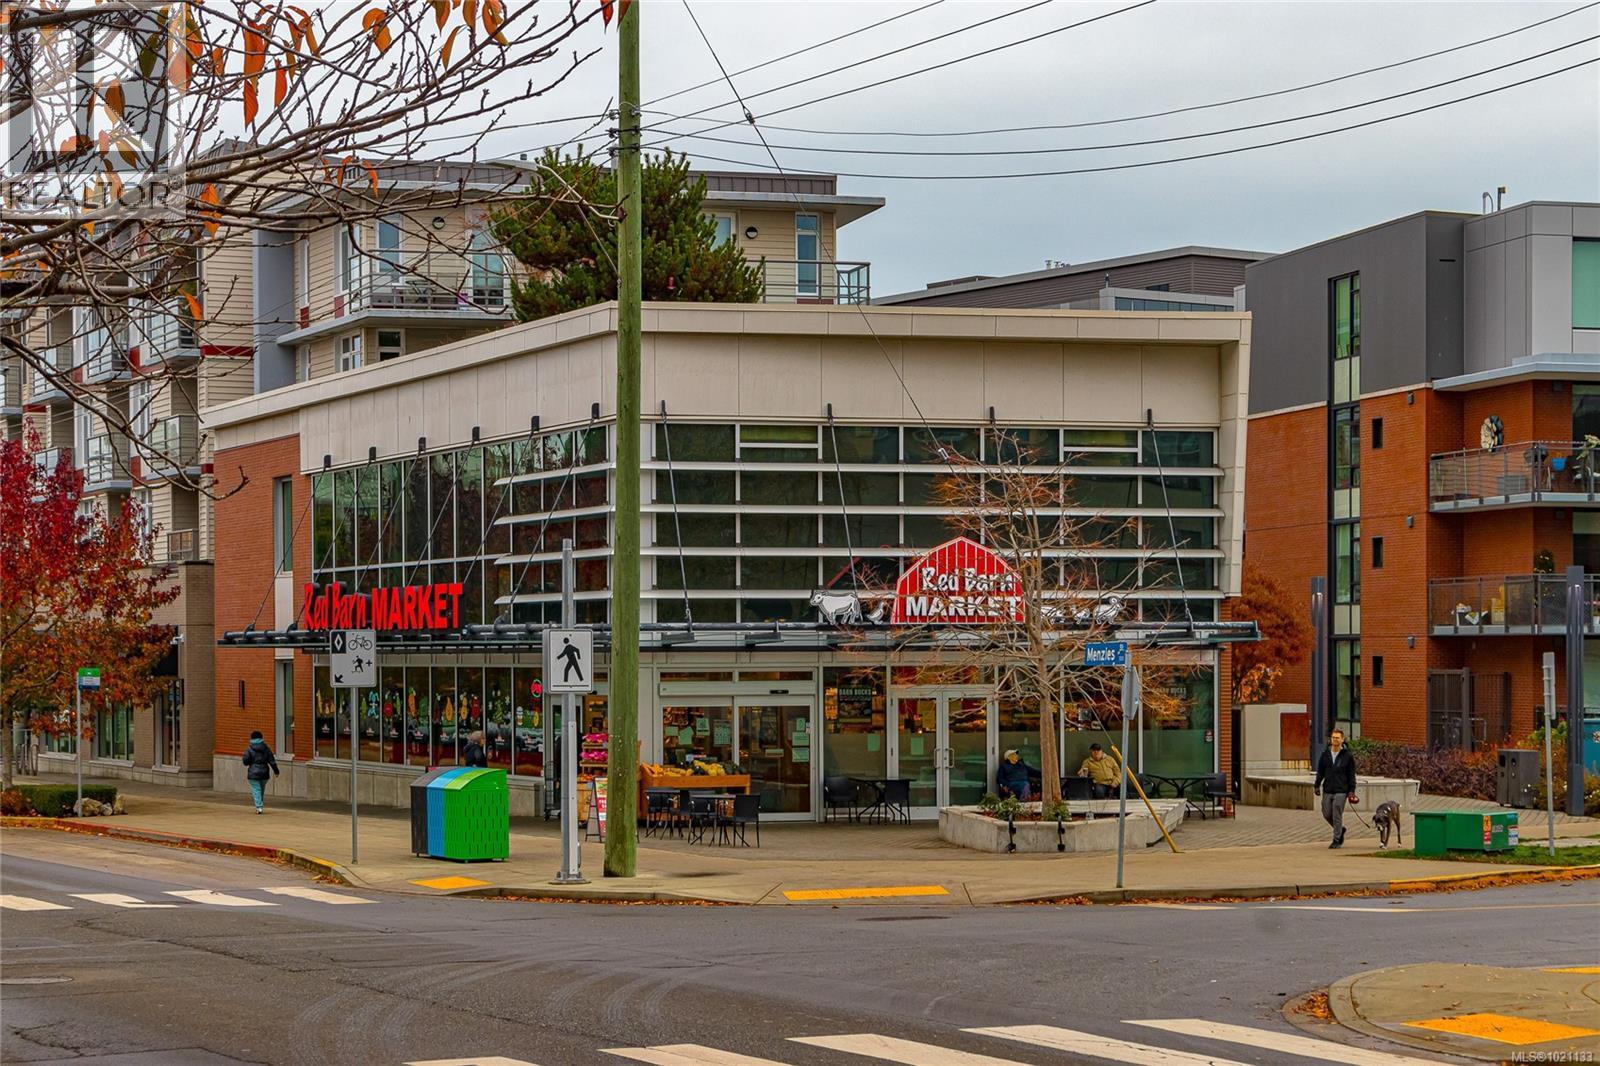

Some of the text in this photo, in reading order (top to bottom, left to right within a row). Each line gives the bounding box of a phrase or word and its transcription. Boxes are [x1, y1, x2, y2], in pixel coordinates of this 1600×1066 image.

[920, 566, 1013, 592] Red Barn
[303, 581, 463, 631] Red Barn MARKET
[905, 596, 1021, 617] MARKET
[1086, 647, 1116, 662] Menzies
